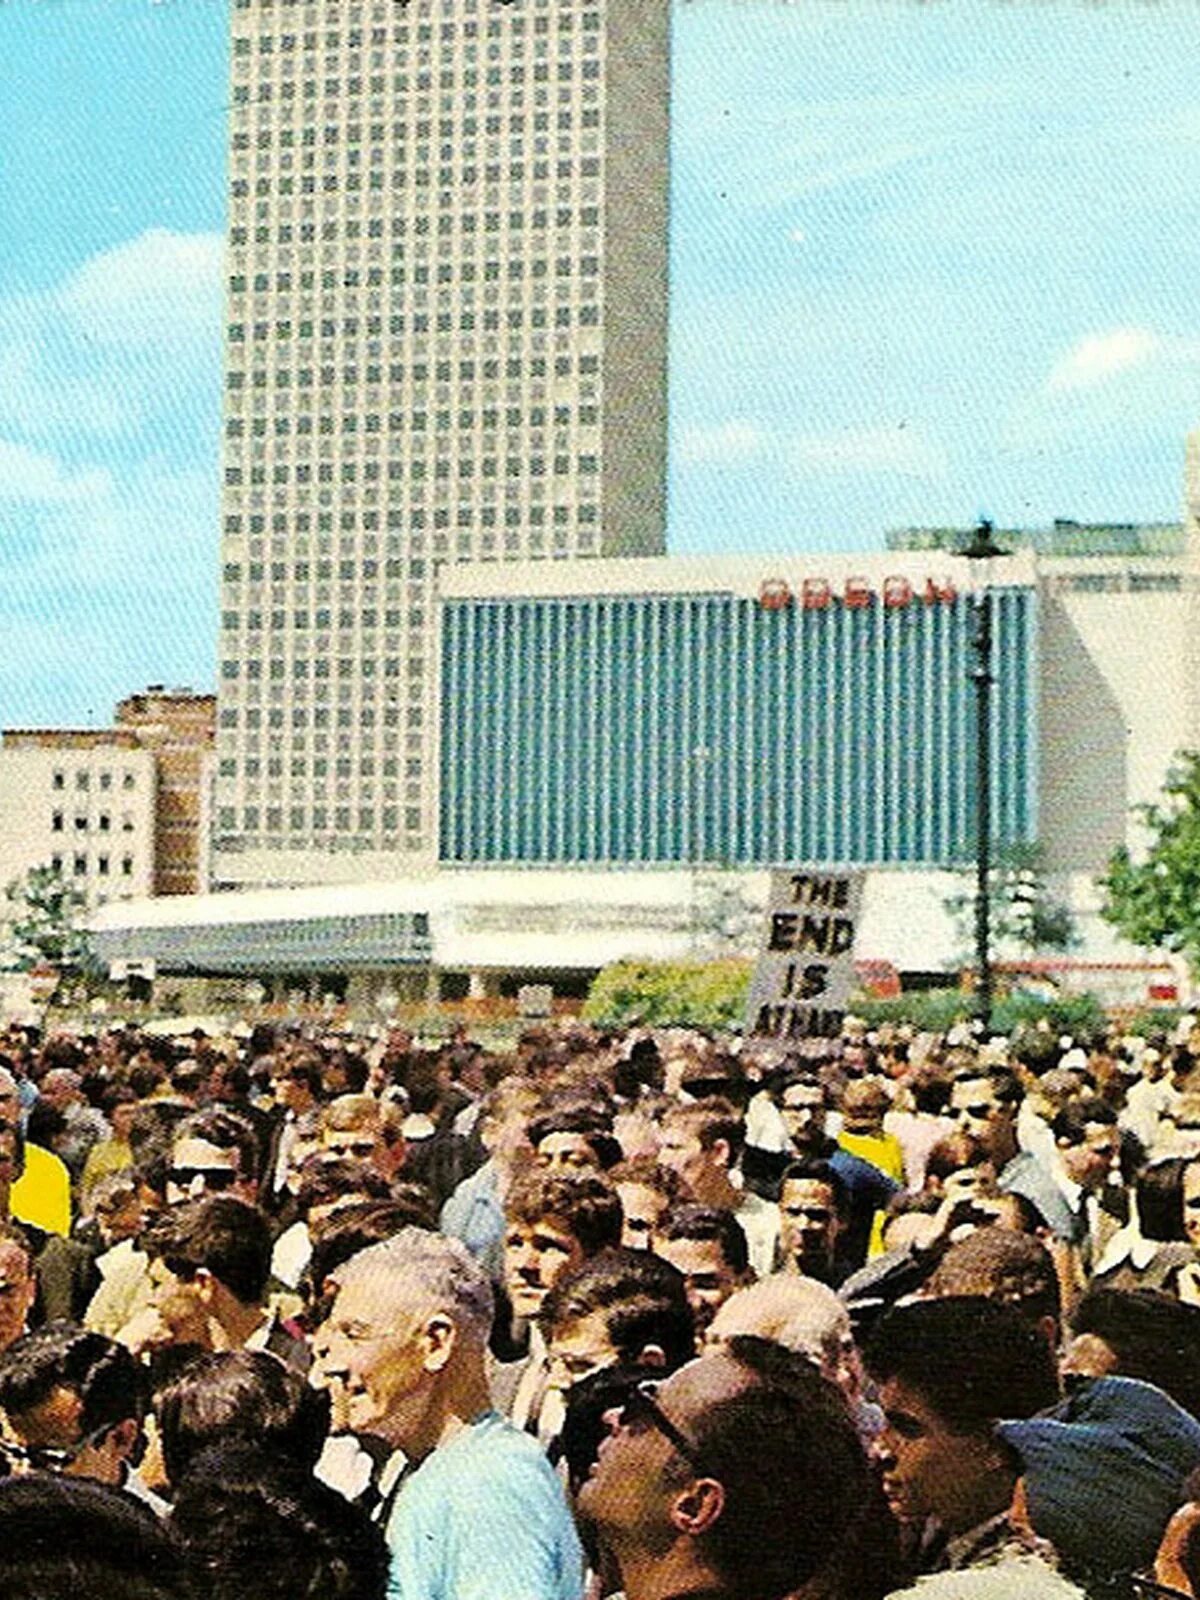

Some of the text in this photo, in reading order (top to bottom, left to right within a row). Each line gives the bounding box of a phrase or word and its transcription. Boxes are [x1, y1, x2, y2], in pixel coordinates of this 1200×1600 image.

[760, 575, 956, 609] ODEON
[790, 874, 850, 908] THE
[768, 913, 854, 954] END
[783, 963, 829, 1000] IS
